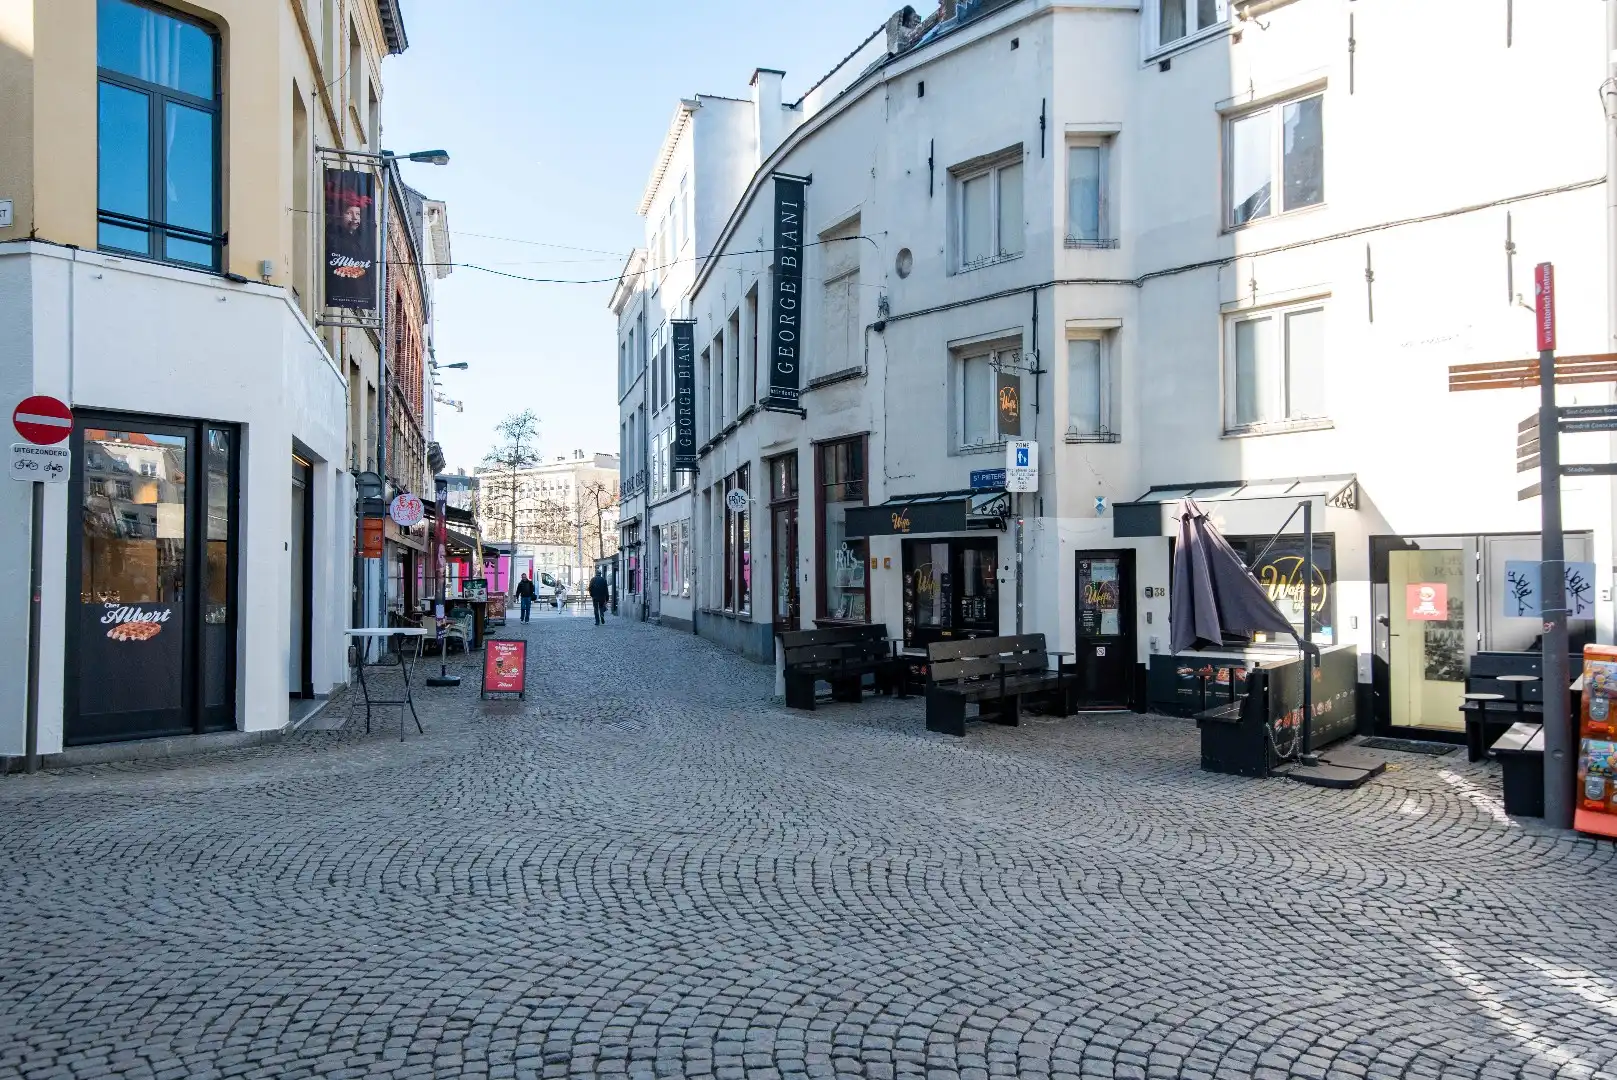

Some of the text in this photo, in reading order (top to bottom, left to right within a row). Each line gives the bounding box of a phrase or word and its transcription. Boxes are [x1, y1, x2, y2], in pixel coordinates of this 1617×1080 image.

[330, 256, 371, 269] Albert
[778, 201, 798, 374] GEORGE BIANI
[678, 336, 692, 447] GEORGE BIANI
[14, 446, 68, 457] UITGEZONDERD
[1567, 465, 1594, 473] Stadhuis
[1261, 557, 1320, 602] Waffe
[1154, 587, 1165, 597] 38
[101, 606, 172, 624] Albert
